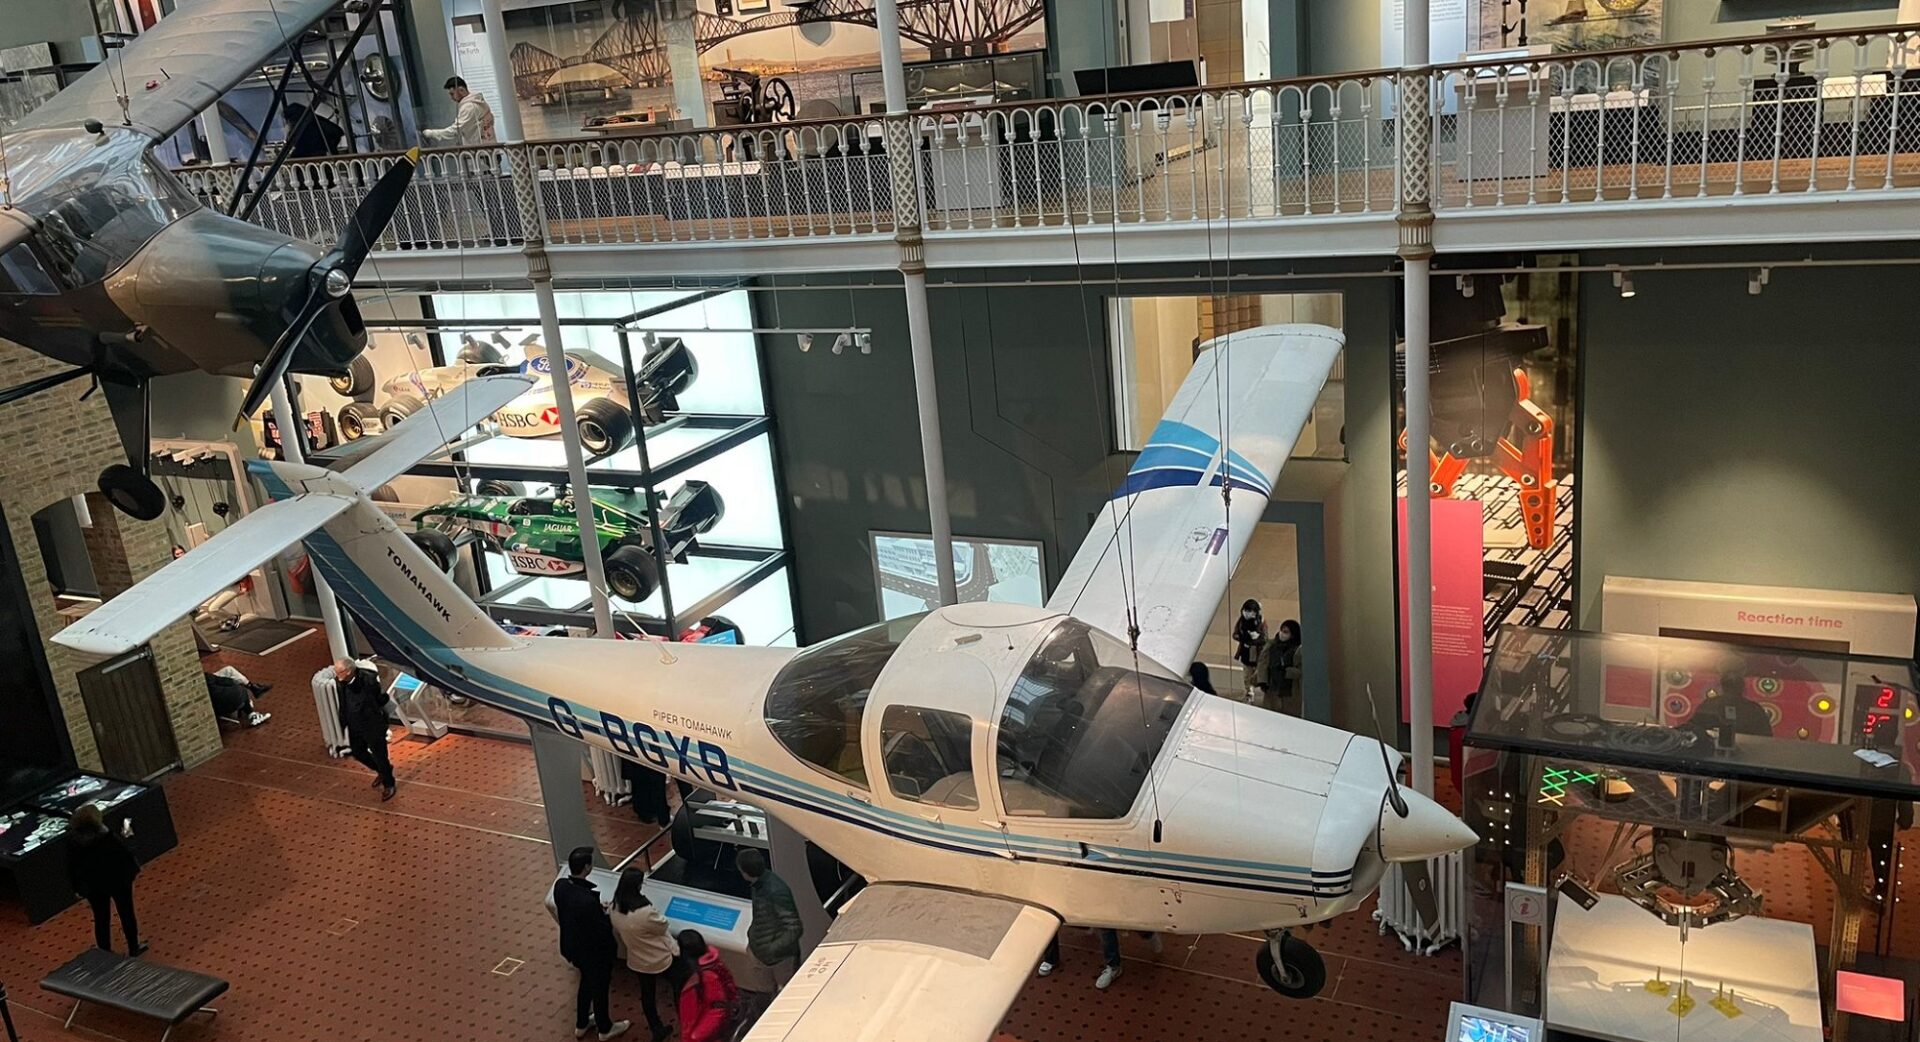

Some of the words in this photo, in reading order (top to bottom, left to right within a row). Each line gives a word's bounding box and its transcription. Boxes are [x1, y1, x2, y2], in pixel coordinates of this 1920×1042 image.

[497, 411, 540, 428] HSBC
[543, 522, 575, 534] JAGUAR
[386, 545, 452, 623] TOMAHAWK
[1737, 610, 1804, 626] Reaction
[1808, 615, 1843, 629] time
[653, 709, 678, 726] PIPER
[680, 717, 733, 740] TOMAHAWK
[547, 696, 738, 792] G-BGXB
